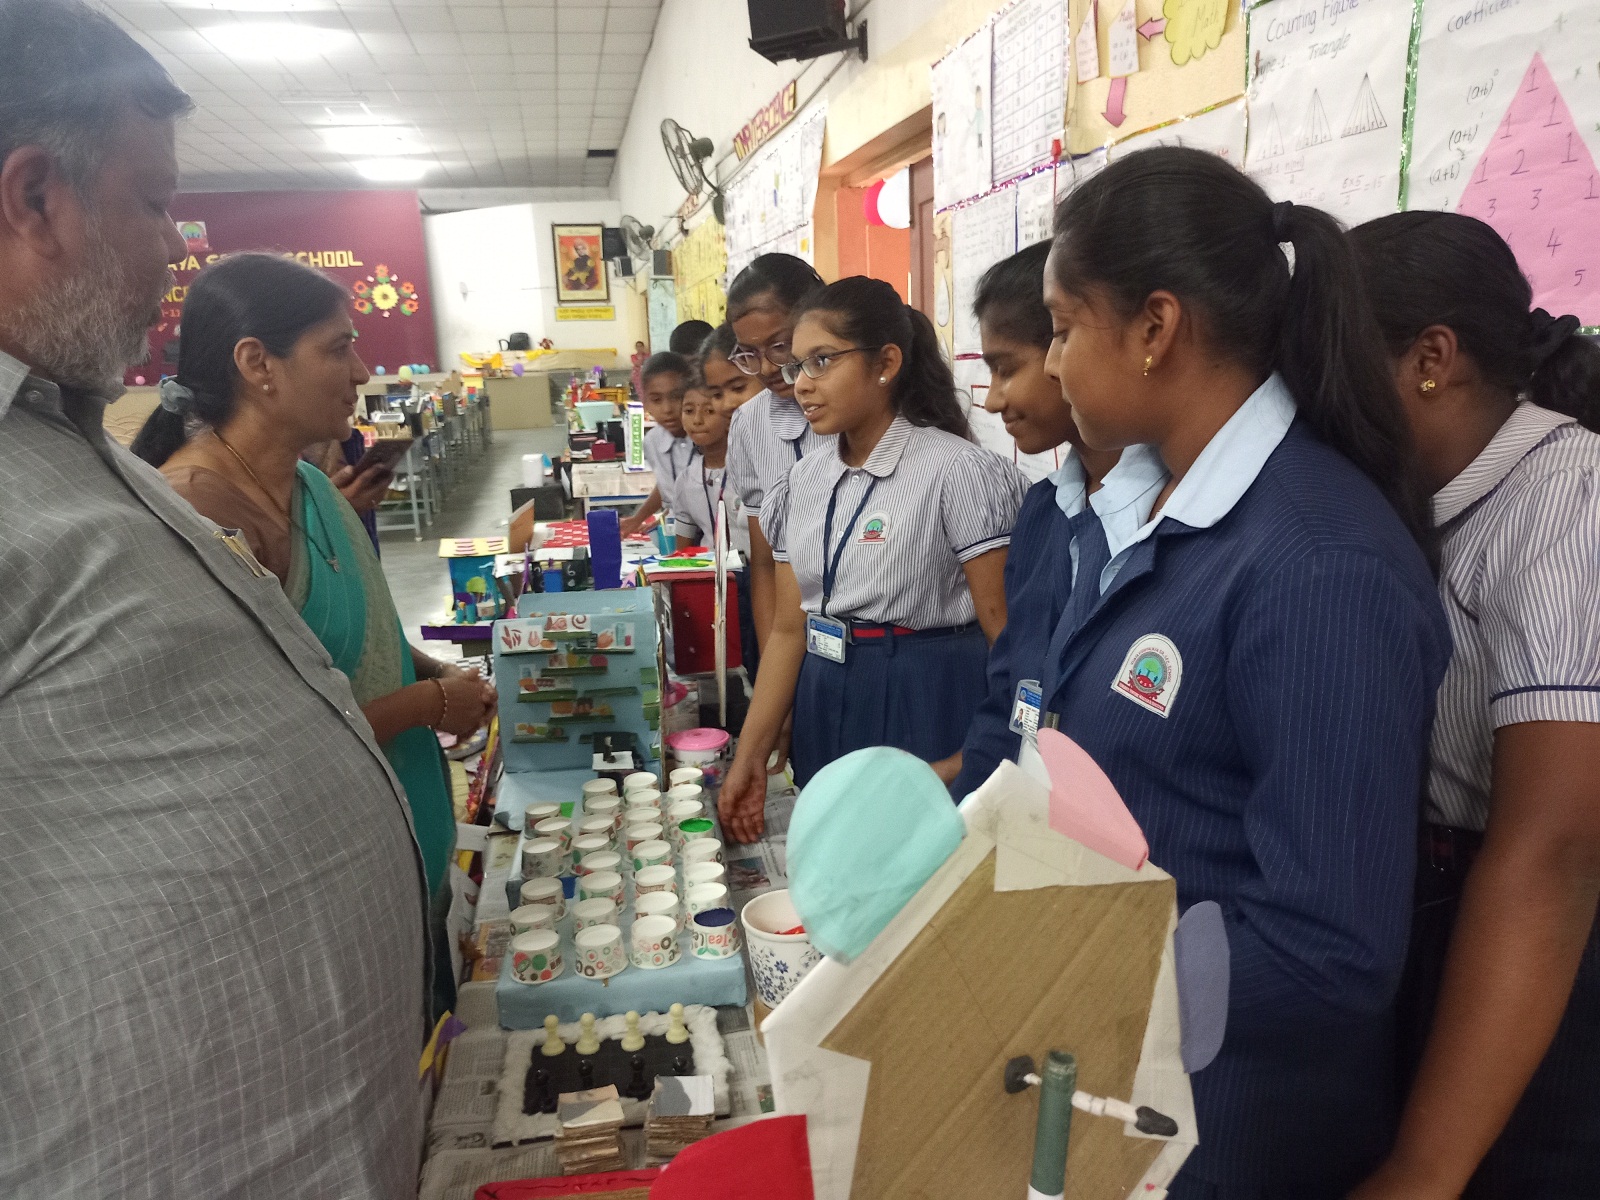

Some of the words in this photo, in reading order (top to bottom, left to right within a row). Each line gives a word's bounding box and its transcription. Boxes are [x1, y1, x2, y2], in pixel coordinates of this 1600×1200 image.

[1266, 9, 1317, 42] Counting
[1308, 27, 1352, 60] Triangle
[1510, 149, 1530, 175] 2
[1487, 198, 1497, 218] 3
[1530, 188, 1542, 210] 3
[1546, 227, 1562, 256] 4
[1573, 269, 1586, 287] 5
[708, 934, 729, 948] Tea
